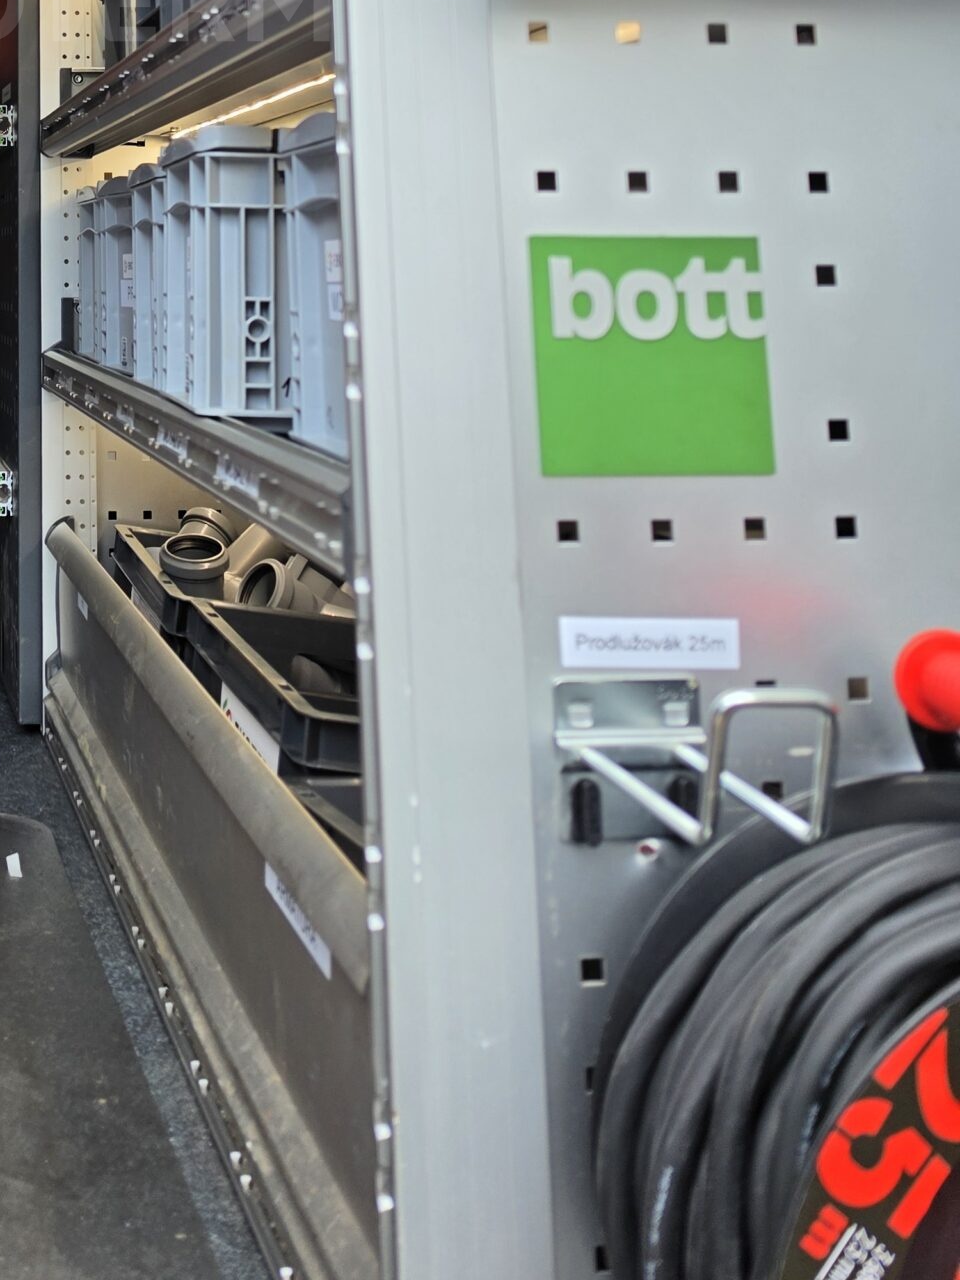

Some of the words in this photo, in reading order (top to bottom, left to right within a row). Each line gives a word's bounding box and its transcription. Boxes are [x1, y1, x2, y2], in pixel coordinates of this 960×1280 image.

[547, 255, 765, 341] bott
[574, 632, 681, 652] Prodlužovák
[688, 634, 727, 652] 25m
